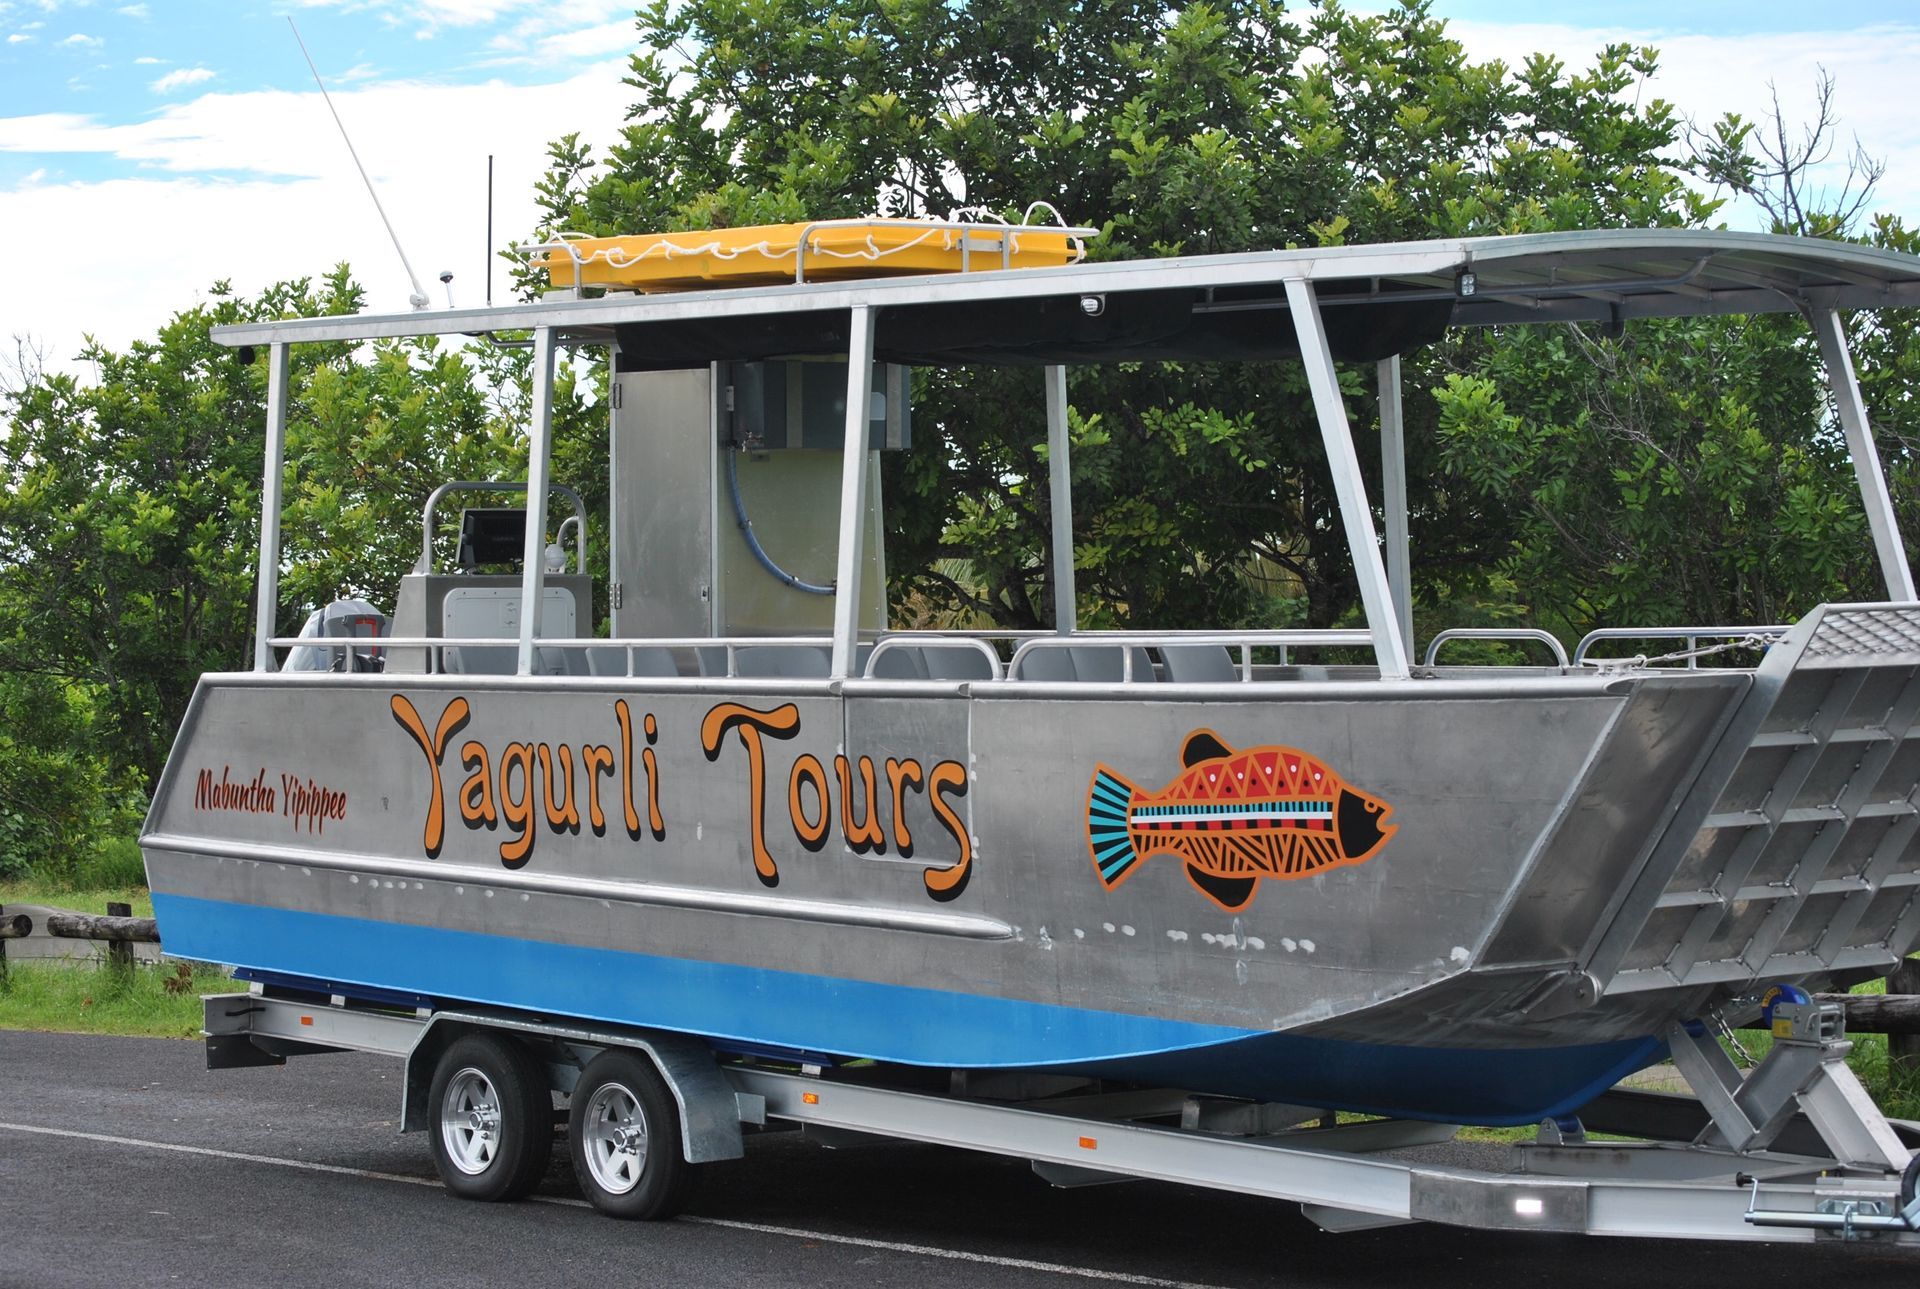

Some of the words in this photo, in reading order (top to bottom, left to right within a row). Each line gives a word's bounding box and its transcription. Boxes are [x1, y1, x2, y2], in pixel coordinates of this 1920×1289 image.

[195, 765, 275, 814] Mabuntha
[281, 773, 346, 835] Yipippee
[390, 693, 666, 870] Yagurli
[701, 702, 972, 902] Tours
